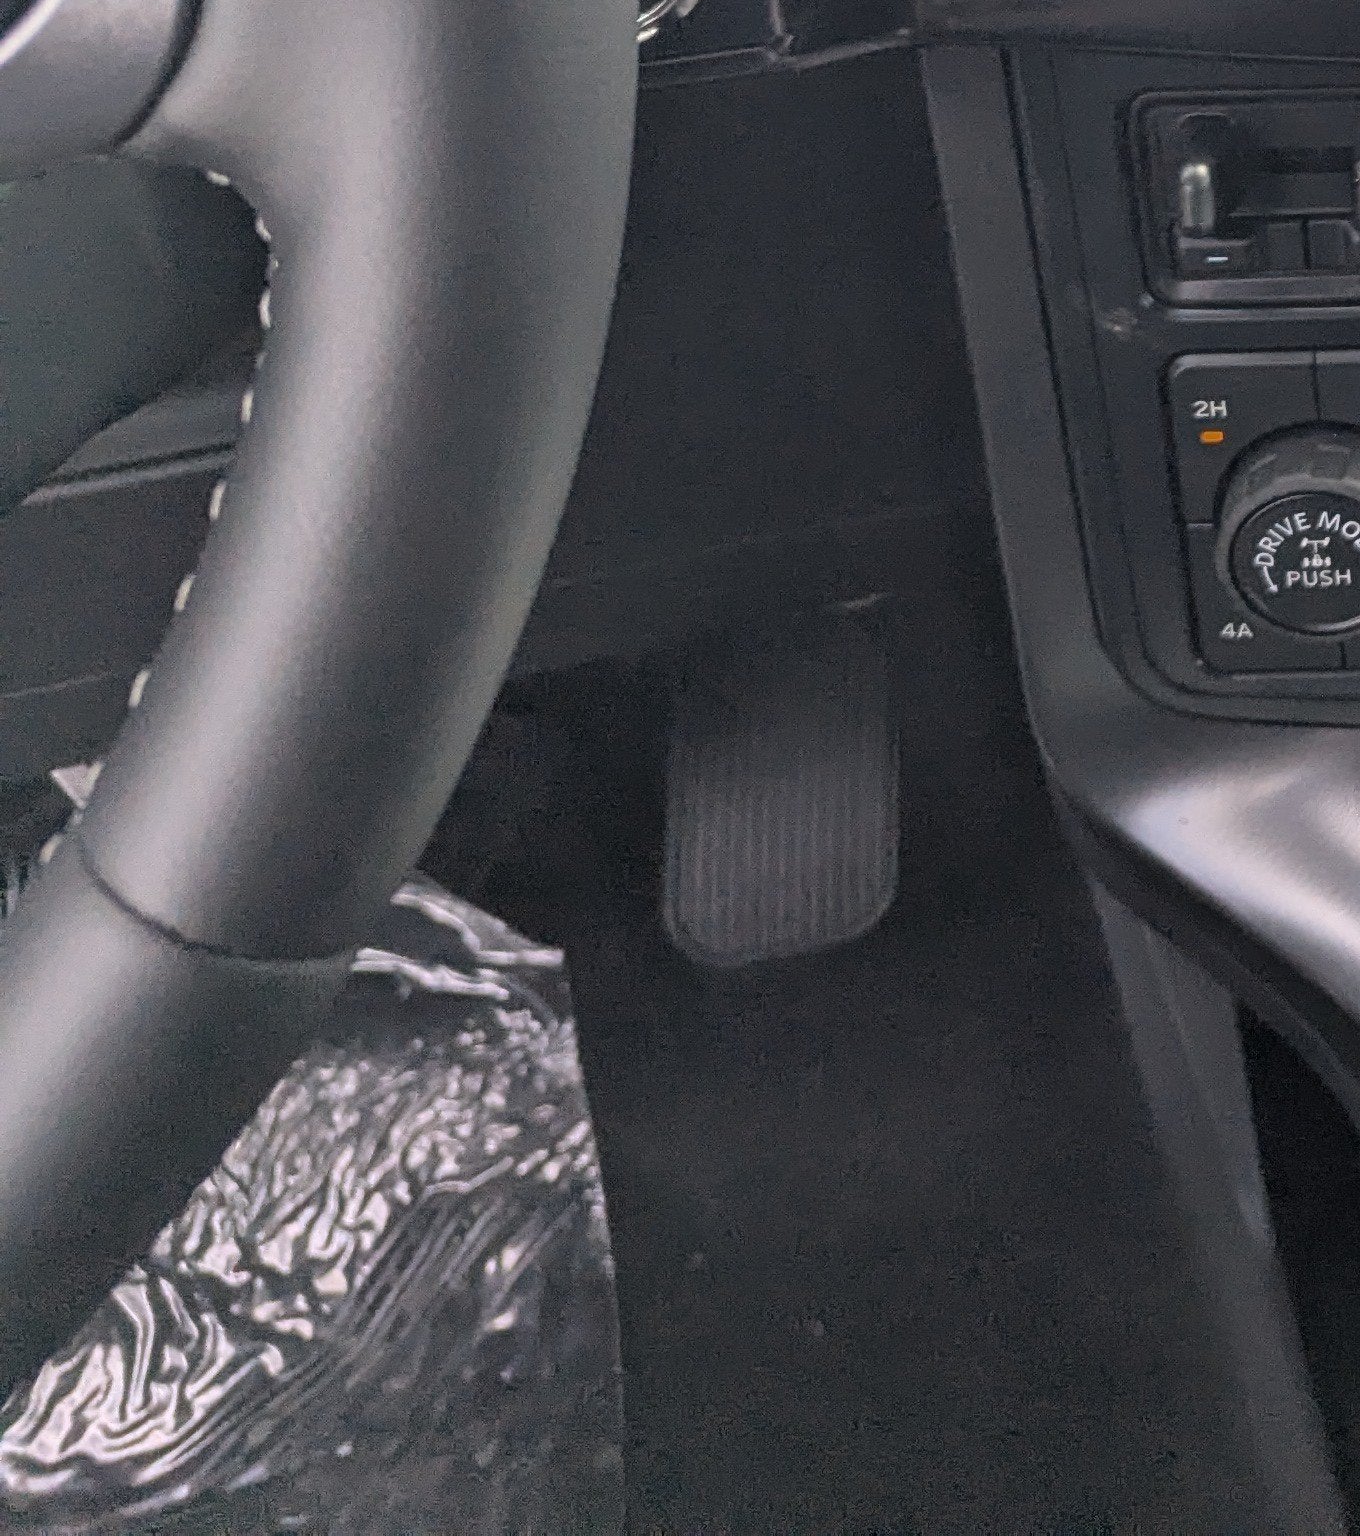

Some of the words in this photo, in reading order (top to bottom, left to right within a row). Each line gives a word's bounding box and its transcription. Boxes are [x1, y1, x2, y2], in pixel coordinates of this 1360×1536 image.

[1192, 399, 1227, 419] 2H
[1251, 510, 1312, 569] DRIVE
[1285, 569, 1353, 589] PUSH
[1219, 621, 1254, 640] 4A
